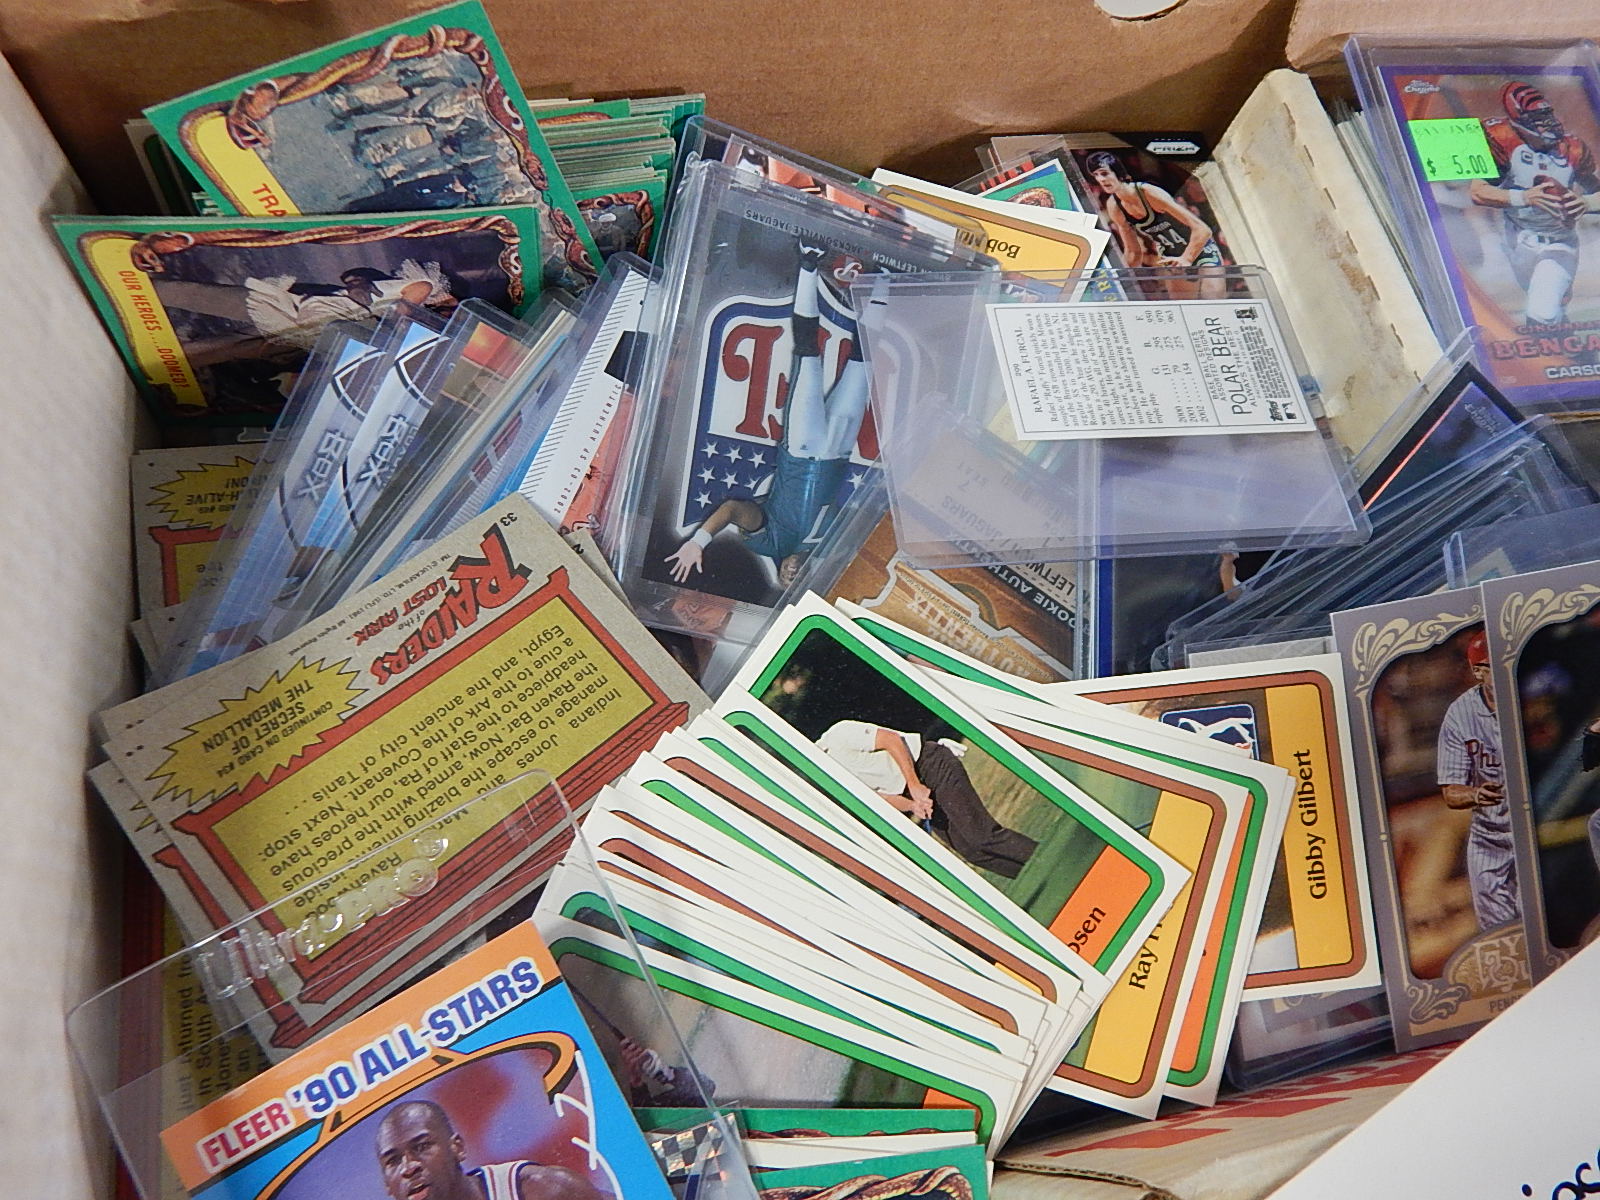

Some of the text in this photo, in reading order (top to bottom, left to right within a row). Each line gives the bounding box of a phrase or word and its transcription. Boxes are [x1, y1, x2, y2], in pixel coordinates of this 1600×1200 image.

[1427, 154, 1489, 176] $ 5.00
[742, 208, 865, 255] JACKSONVILLE JAGUARS
[984, 236, 1020, 258] Bob
[118, 271, 142, 289] OUR
[871, 252, 917, 273] LEFTWICH
[1014, 330, 1030, 362] FURCAL
[1204, 318, 1232, 356] BEAR
[1192, 332, 1219, 399] BASE BALL SERIES
[1198, 330, 1227, 400] ASSORTED DESIGNS
[1233, 352, 1244, 366] THE
[1026, 380, 1042, 411] RAFAEL
[1220, 364, 1252, 414] POLAR
[1240, 372, 1258, 406] ALWAYS
[554, 384, 624, 514] 2002-03 SP AUTHENTIC
[500, 512, 518, 526] 33
[352, 576, 451, 646] LOST ARK
[371, 524, 533, 684] RAIDERS
[398, 610, 426, 630] of the
[312, 624, 564, 802] Egypt, and the ancient city of Tanis
[554, 674, 608, 718] manage
[568, 688, 622, 728] Indiana
[202, 680, 314, 753] THE MEDALLION
[232, 702, 306, 756] SECRET OF
[280, 702, 332, 738] CONTINUED
[538, 716, 556, 730] to
[238, 744, 264, 766] CARD
[256, 638, 574, 862] a clue to the Ark of the Covenant. Next stop:
[264, 734, 280, 748] ON
[486, 728, 536, 768] escape
[516, 734, 558, 768] Jones
[270, 650, 588, 876] headpiece to the Staff of Ra, our heroes have
[282, 662, 598, 892] the Raven Bar. Now, armed with the precious
[460, 766, 486, 788] the
[402, 786, 462, 828] blazing
[1294, 748, 1328, 900] Gibby Gilbert
[1128, 943, 1158, 990] Ray
[202, 1103, 290, 1167] FLEER
[359, 961, 540, 1085] ALL-STARS
